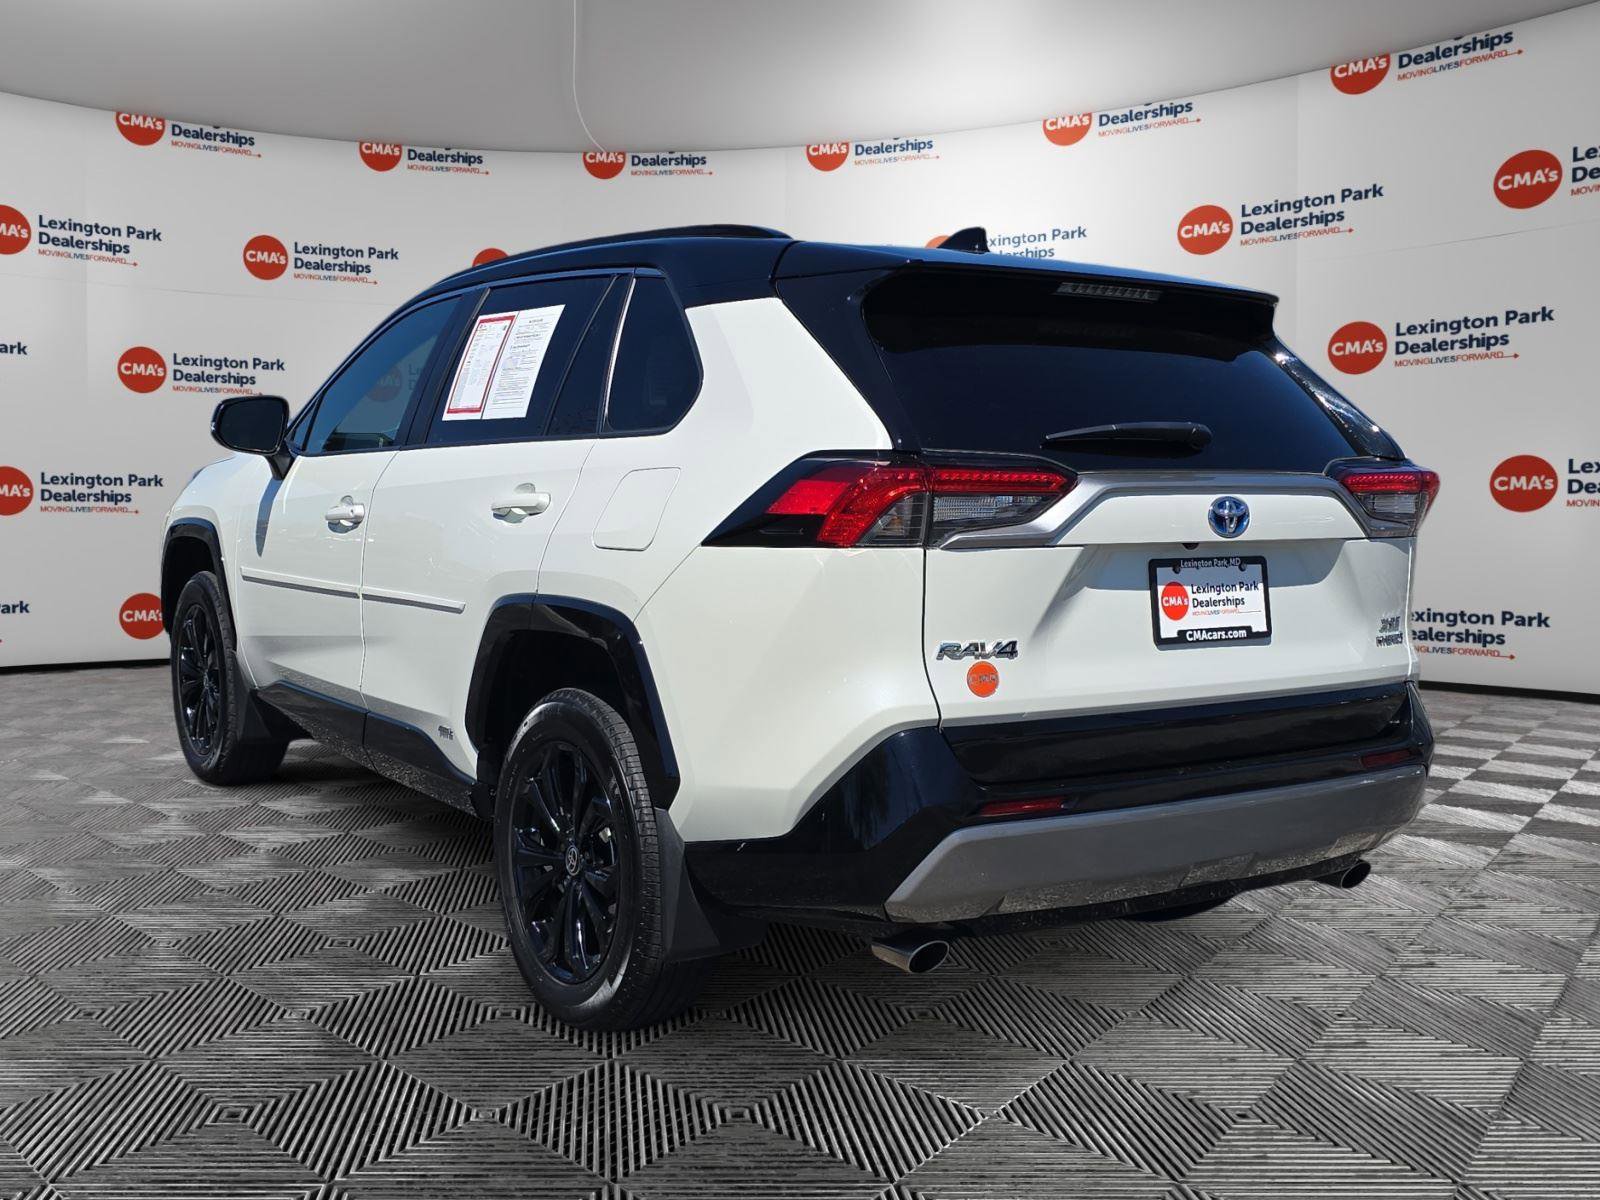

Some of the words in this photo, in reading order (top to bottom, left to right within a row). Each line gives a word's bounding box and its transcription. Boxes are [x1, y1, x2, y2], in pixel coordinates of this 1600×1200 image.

[1397, 30, 1514, 70] Dealerships
[1334, 57, 1388, 79] CMA's
[1397, 50, 1508, 82] MOVINGLIVESFORWARD
[118, 112, 163, 131] CMA's
[1045, 112, 1091, 131] CMA's
[1098, 100, 1194, 127] Dealerships
[170, 124, 256, 147] Dealerships
[1098, 115, 1189, 138] MOVINGLIVESFORWARD
[170, 140, 253, 157] MOVINGLIVESFORWARD
[361, 142, 400, 156] CMA's
[809, 142, 848, 156] CMA's
[854, 136, 934, 156] Dealerships
[407, 148, 484, 166] Dealerships
[585, 152, 624, 164] CMA's
[631, 153, 707, 168] Dealerships
[1497, 167, 1559, 191] CMA's
[1240, 194, 1335, 218] Lexington
[1340, 183, 1384, 203] Park
[38, 214, 122, 237] Lexington
[126, 225, 163, 242] Park
[1180, 221, 1231, 239] CMA's
[1240, 208, 1345, 236] Dealerships
[38, 231, 131, 256] Dealerships
[986, 231, 1047, 249] xington
[1052, 226, 1088, 241] Park
[1240, 227, 1341, 247] MOVINGLIVESFORWARD
[38, 249, 127, 265] MOVINGLIVESFORWARD
[245, 250, 287, 266] CMA's
[293, 241, 363, 261] Lexington
[367, 246, 399, 260] Park
[293, 256, 372, 277] Dealerships
[1394, 312, 1500, 337] Lexington
[1504, 306, 1555, 325] Park
[0, 341, 28, 355] ark
[1330, 338, 1384, 356] CMA's
[1394, 332, 1510, 356] Dealerships
[172, 353, 249, 372] Lexington
[253, 357, 286, 371] Park
[1394, 351, 1505, 368] MOVINGLIVESFORWARD
[119, 361, 165, 377] CMA's
[172, 369, 257, 388] Dealerships
[41, 472, 123, 489] Lexington
[128, 474, 163, 487] Park
[1493, 474, 1554, 491] CMA's
[0, 484, 31, 498] MA's
[40, 488, 132, 506] Dealerships
[40, 505, 128, 514] MOVINGLIVESFORWARD
[1180, 560, 1212, 570] Lexington
[1191, 584, 1237, 596] Lexington
[1238, 581, 1260, 592] Park
[0, 601, 29, 614] ark
[1162, 596, 1189, 607] CMA's
[1192, 595, 1246, 609] Dealerships
[1411, 608, 1495, 626] xington
[1501, 610, 1551, 628] Park
[1186, 629, 1247, 642] CMAcars.com
[1412, 627, 1506, 647] ealerships
[936, 640, 1018, 660] RAV4
[1414, 645, 1501, 658] NGLIVESFORWARD
